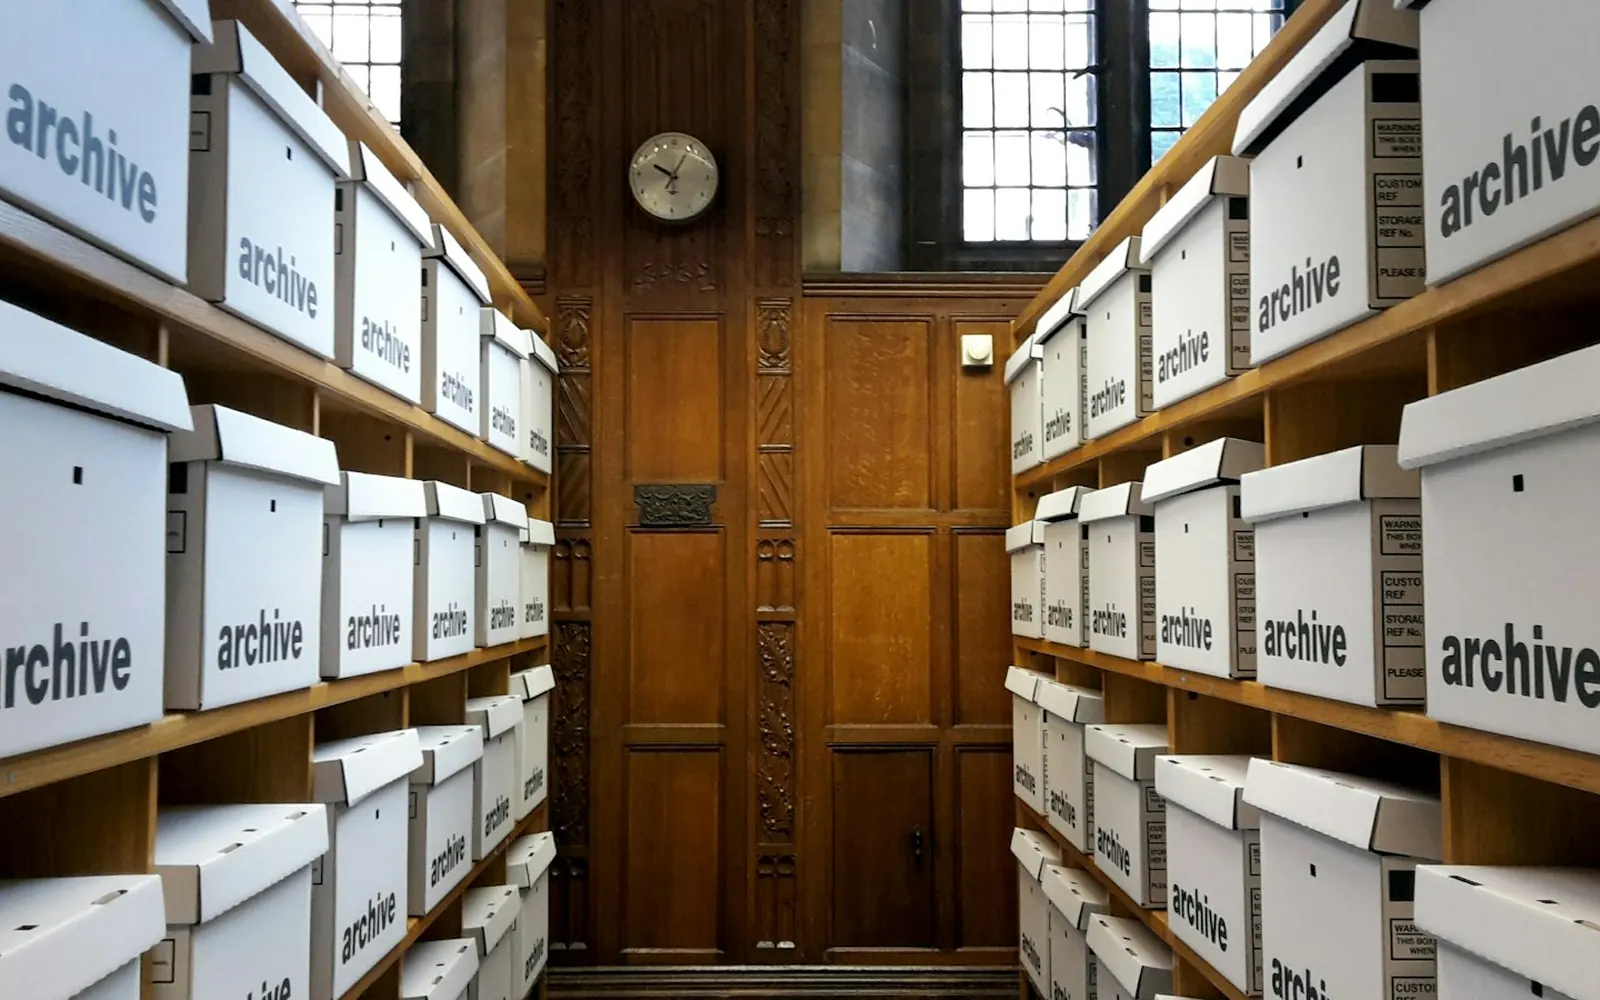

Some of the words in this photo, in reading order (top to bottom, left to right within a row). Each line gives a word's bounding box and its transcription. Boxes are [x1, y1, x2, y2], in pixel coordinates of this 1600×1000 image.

[6, 84, 157, 224] archive
[1441, 105, 1600, 238] archive
[1377, 179, 1422, 189] CUSTOM
[1378, 191, 1398, 201] REF
[1379, 228, 1397, 237] REF
[239, 237, 318, 319] archive
[1380, 268, 1417, 277] PLEASE
[1259, 255, 1341, 333] archive
[362, 316, 410, 374] archive
[1158, 329, 1209, 384] archive
[442, 371, 472, 413] archive
[1091, 377, 1125, 418] archive
[493, 407, 515, 439] archive
[1046, 409, 1070, 442] archive
[1384, 520, 1421, 529] WARNIN
[1385, 577, 1421, 587] CUSTO
[1386, 590, 1406, 600] REF
[348, 605, 400, 650] archive
[433, 603, 467, 639] archive
[491, 600, 514, 629] archive
[526, 597, 543, 623] archive
[1013, 597, 1033, 623] archive
[1048, 600, 1072, 629] archive
[1093, 603, 1126, 638] archive
[1386, 614, 1423, 624] STORA
[218, 609, 302, 671] archive
[1162, 607, 1212, 651] archive
[1265, 609, 1347, 667] archive
[1386, 627, 1405, 637] REF
[0, 622, 131, 709] rchive
[1388, 668, 1424, 678] PLEASE
[1442, 623, 1600, 708] archive
[524, 767, 543, 801] archive
[1016, 764, 1036, 796] archive
[485, 794, 510, 837] archive
[1051, 790, 1076, 829] archive
[431, 834, 465, 887] archive
[1097, 827, 1131, 877] archive
[342, 892, 396, 965] archive
[1172, 884, 1228, 952] archive
[1397, 937, 1415, 946] THIS
[1396, 983, 1435, 993] CUSTO
